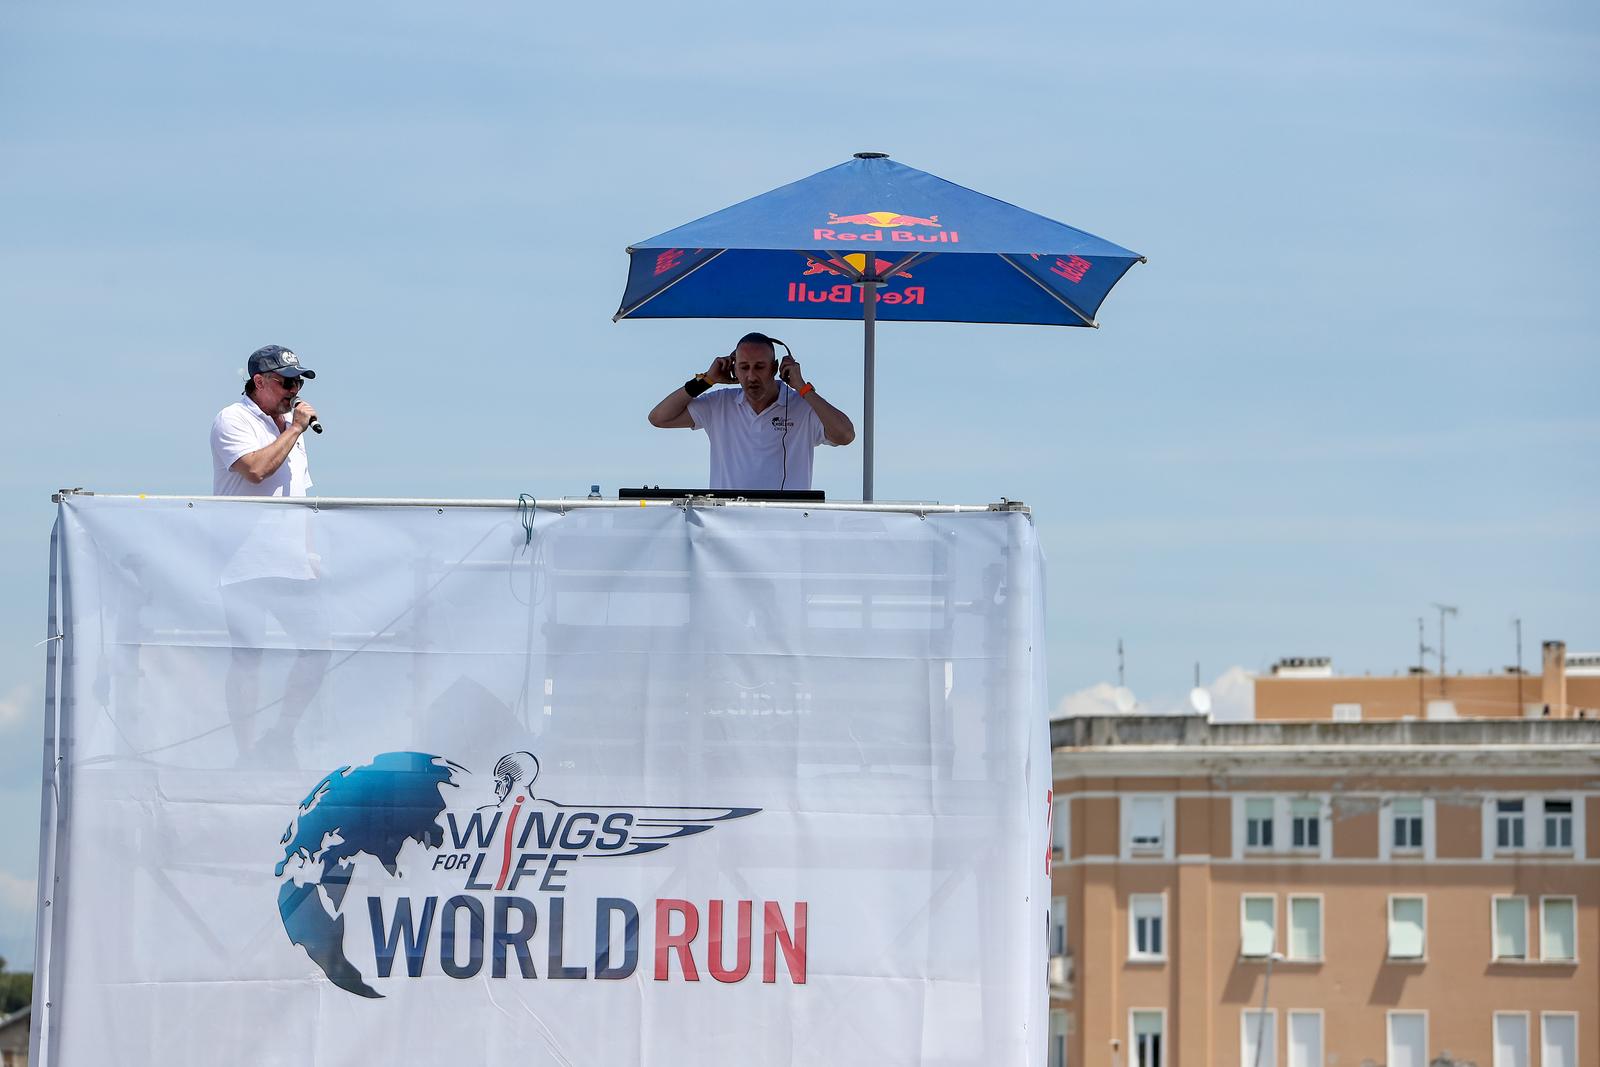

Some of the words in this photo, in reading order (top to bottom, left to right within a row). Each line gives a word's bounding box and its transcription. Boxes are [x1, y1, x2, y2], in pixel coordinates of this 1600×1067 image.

[813, 228, 883, 241] Red
[891, 230, 959, 243] Bull
[432, 853, 471, 871] FOR
[464, 853, 580, 891] LIFE
[366, 895, 640, 980] WORLD
[653, 898, 808, 984] RUN
